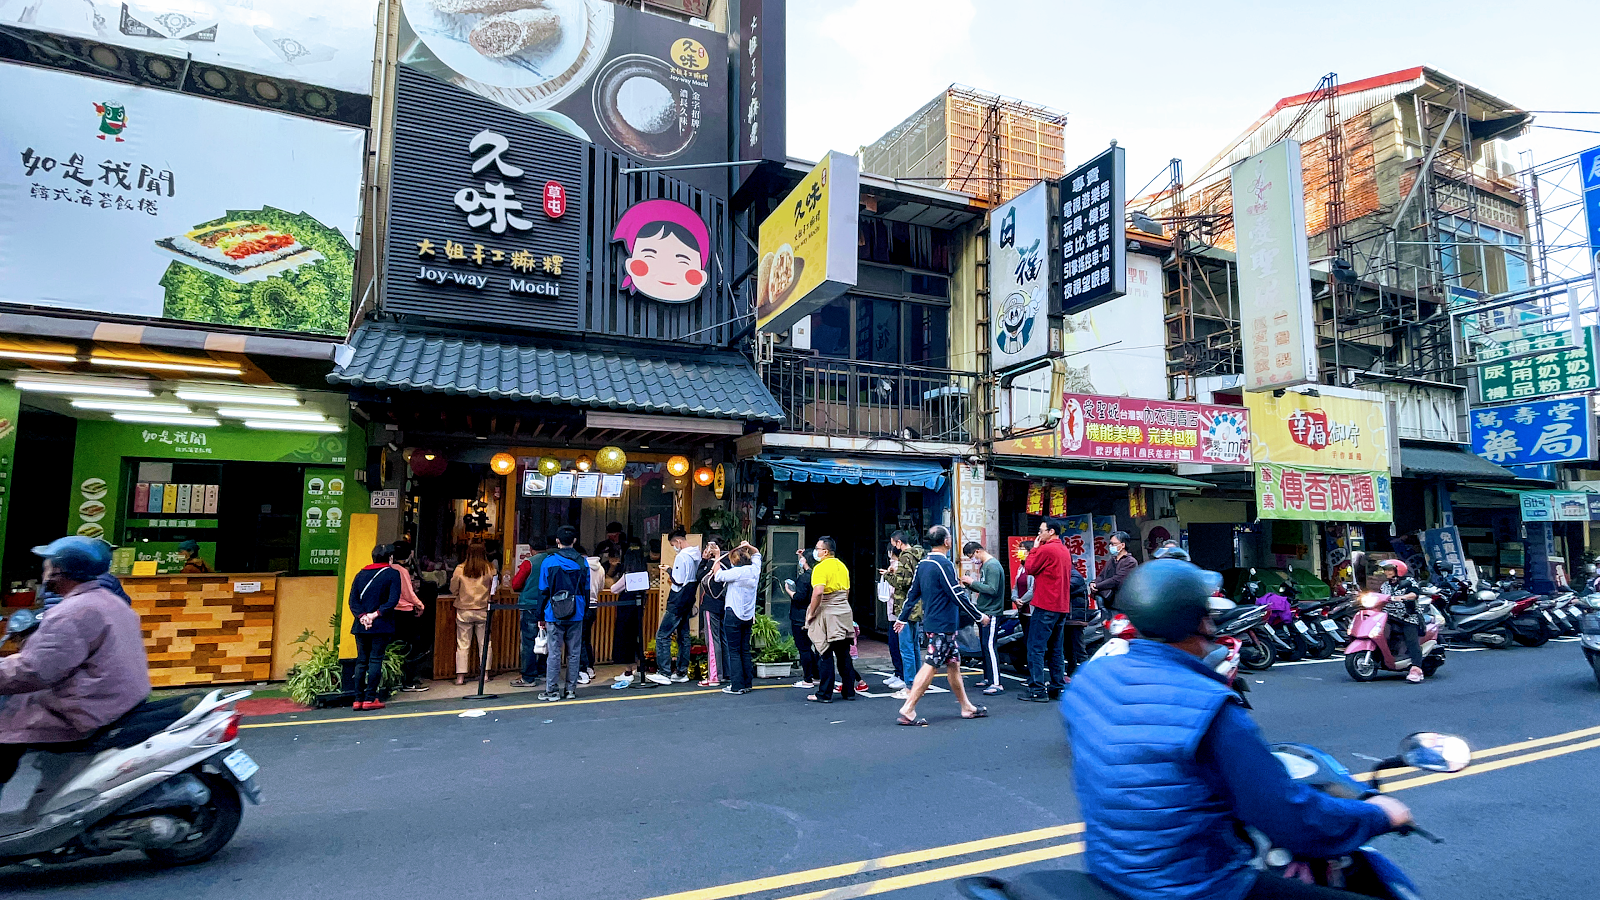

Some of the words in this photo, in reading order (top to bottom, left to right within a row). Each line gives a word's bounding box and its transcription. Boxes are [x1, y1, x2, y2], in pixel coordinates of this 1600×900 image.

[680, 40, 699, 68] 久味
[20, 147, 175, 197] 如是我聞
[454, 129, 533, 233] 久味
[547, 185, 561, 213] 草屯
[794, 182, 822, 227] 久味
[1063, 180, 1110, 218] 電視遊樂器
[1063, 223, 1110, 258] 芭比娃娃
[416, 267, 487, 289] Joy-way
[510, 279, 560, 296] Mochi
[1085, 422, 1141, 443] 機能美學
[1475, 403, 1580, 429] 萬壽堂
[1477, 422, 1582, 462] 藥局
[1280, 469, 1375, 512] 傳香飯糰
